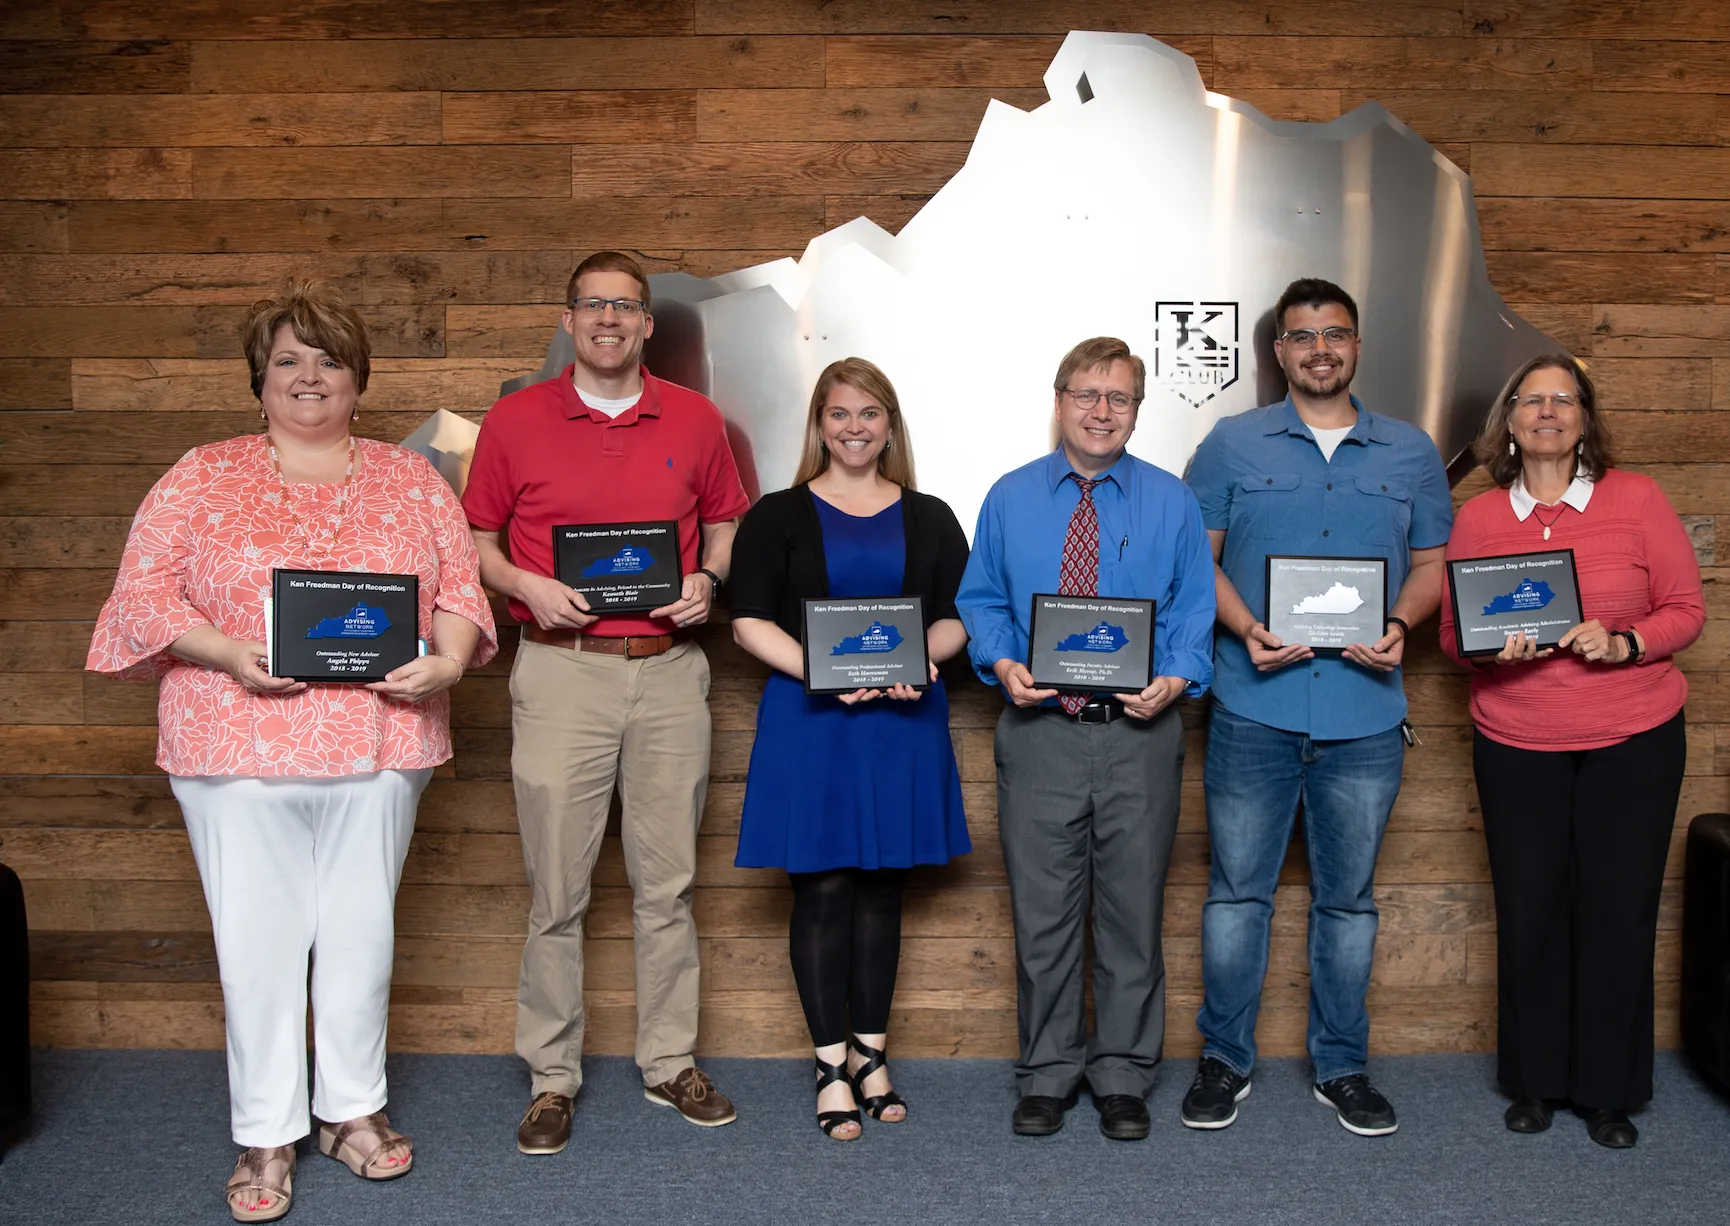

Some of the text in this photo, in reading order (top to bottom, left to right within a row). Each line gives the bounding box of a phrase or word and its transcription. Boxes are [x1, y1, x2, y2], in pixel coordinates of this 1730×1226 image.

[1170, 311, 1228, 350] K
[1527, 559, 1563, 568] Recognition
[306, 581, 340, 589] Freedman
[342, 583, 356, 591] Day
[366, 584, 405, 592] Recognition
